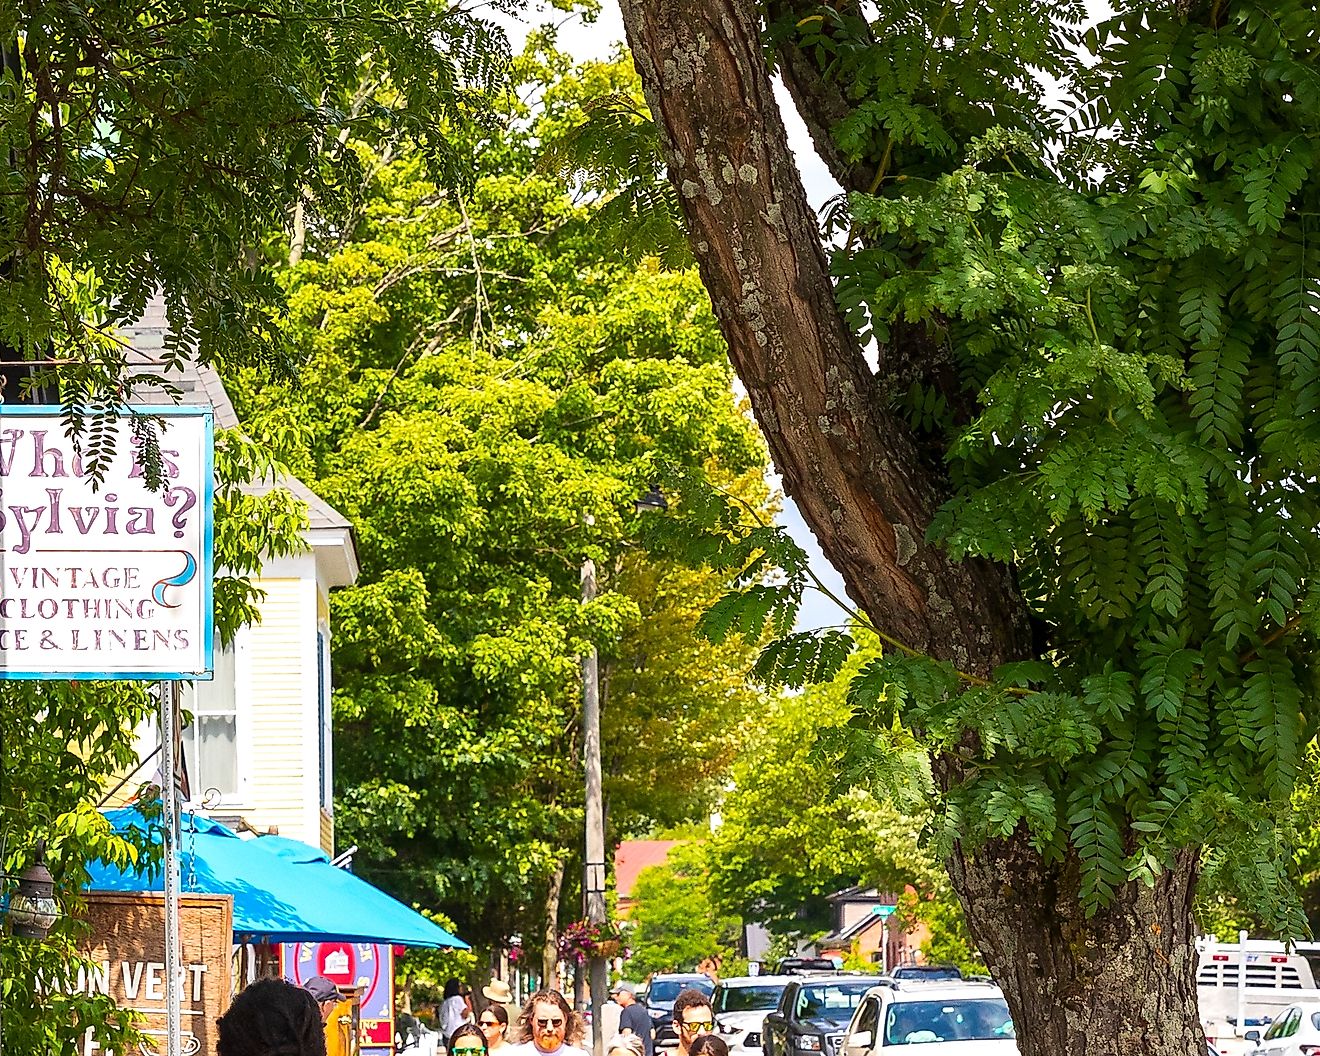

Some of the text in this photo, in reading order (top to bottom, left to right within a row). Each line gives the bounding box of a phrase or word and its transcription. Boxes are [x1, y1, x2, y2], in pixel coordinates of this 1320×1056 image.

[9, 567, 141, 589] VINTAGE
[0, 598, 155, 620] CLOTHING
[39, 629, 63, 651] &
[71, 629, 190, 651] LINENS
